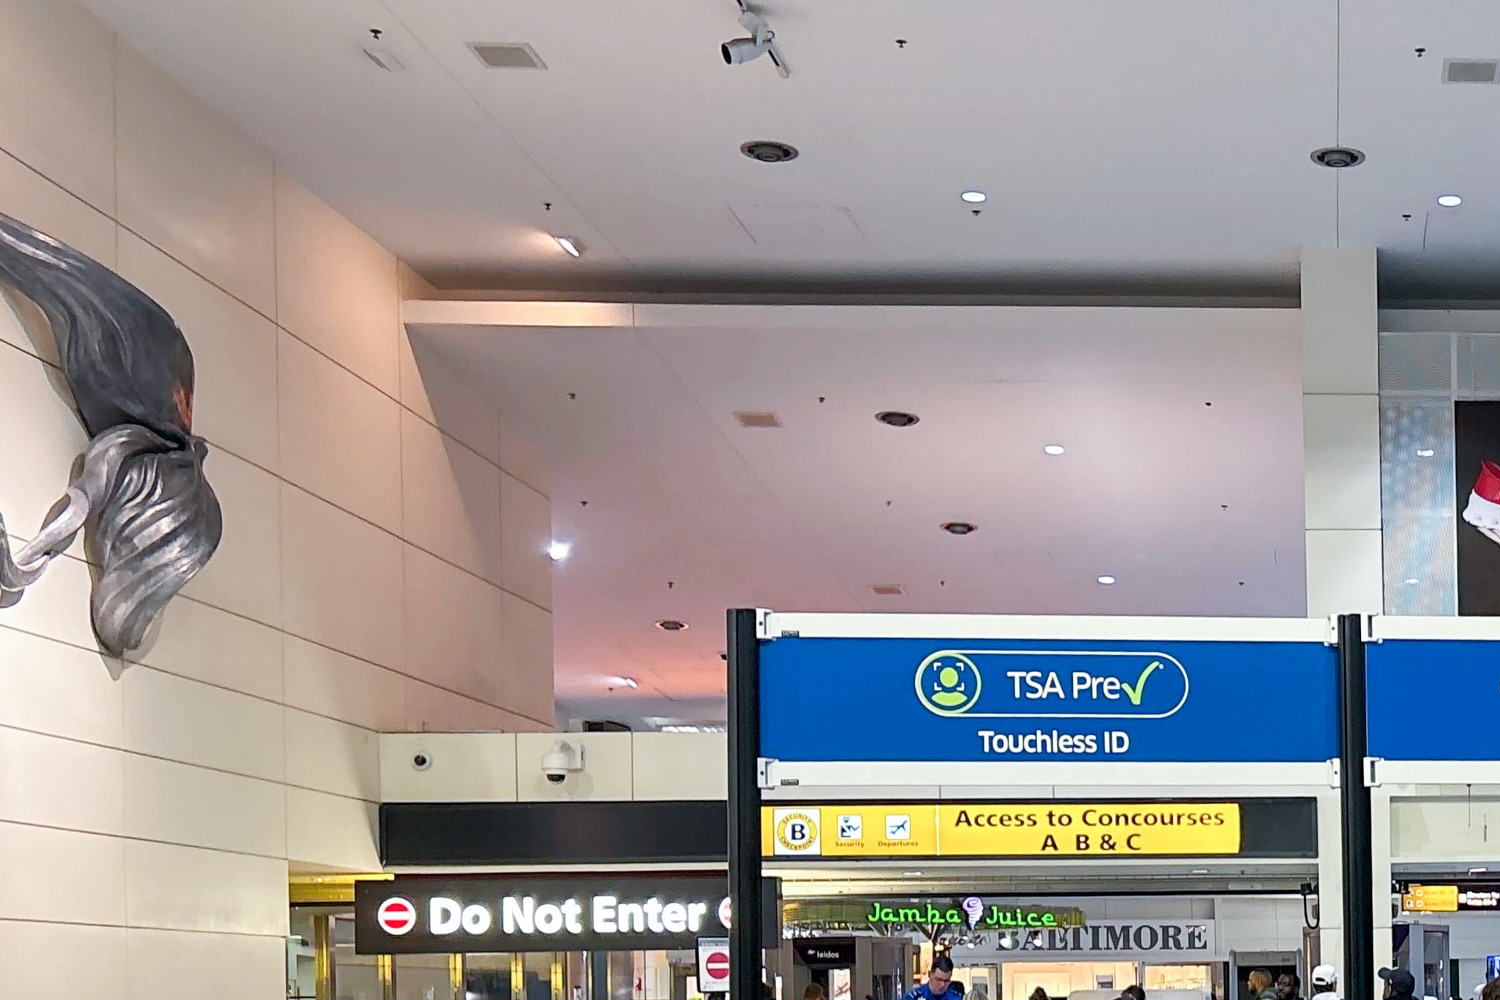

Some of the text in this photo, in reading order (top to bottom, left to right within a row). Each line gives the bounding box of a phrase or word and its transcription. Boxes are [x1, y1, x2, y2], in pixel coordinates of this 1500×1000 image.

[1007, 670, 1121, 700] TSA Pre
[978, 730, 1130, 754] Touchless ID
[955, 809, 1225, 828] Access to Concourses
[791, 823, 806, 841] B
[1041, 833, 1142, 851] A B & C
[835, 840, 865, 849] Security
[878, 840, 919, 848] Departures
[429, 895, 707, 936] Do Not Enter
[868, 902, 1057, 928] Jamba Juice
[996, 924, 1208, 952] BALTIMORE
